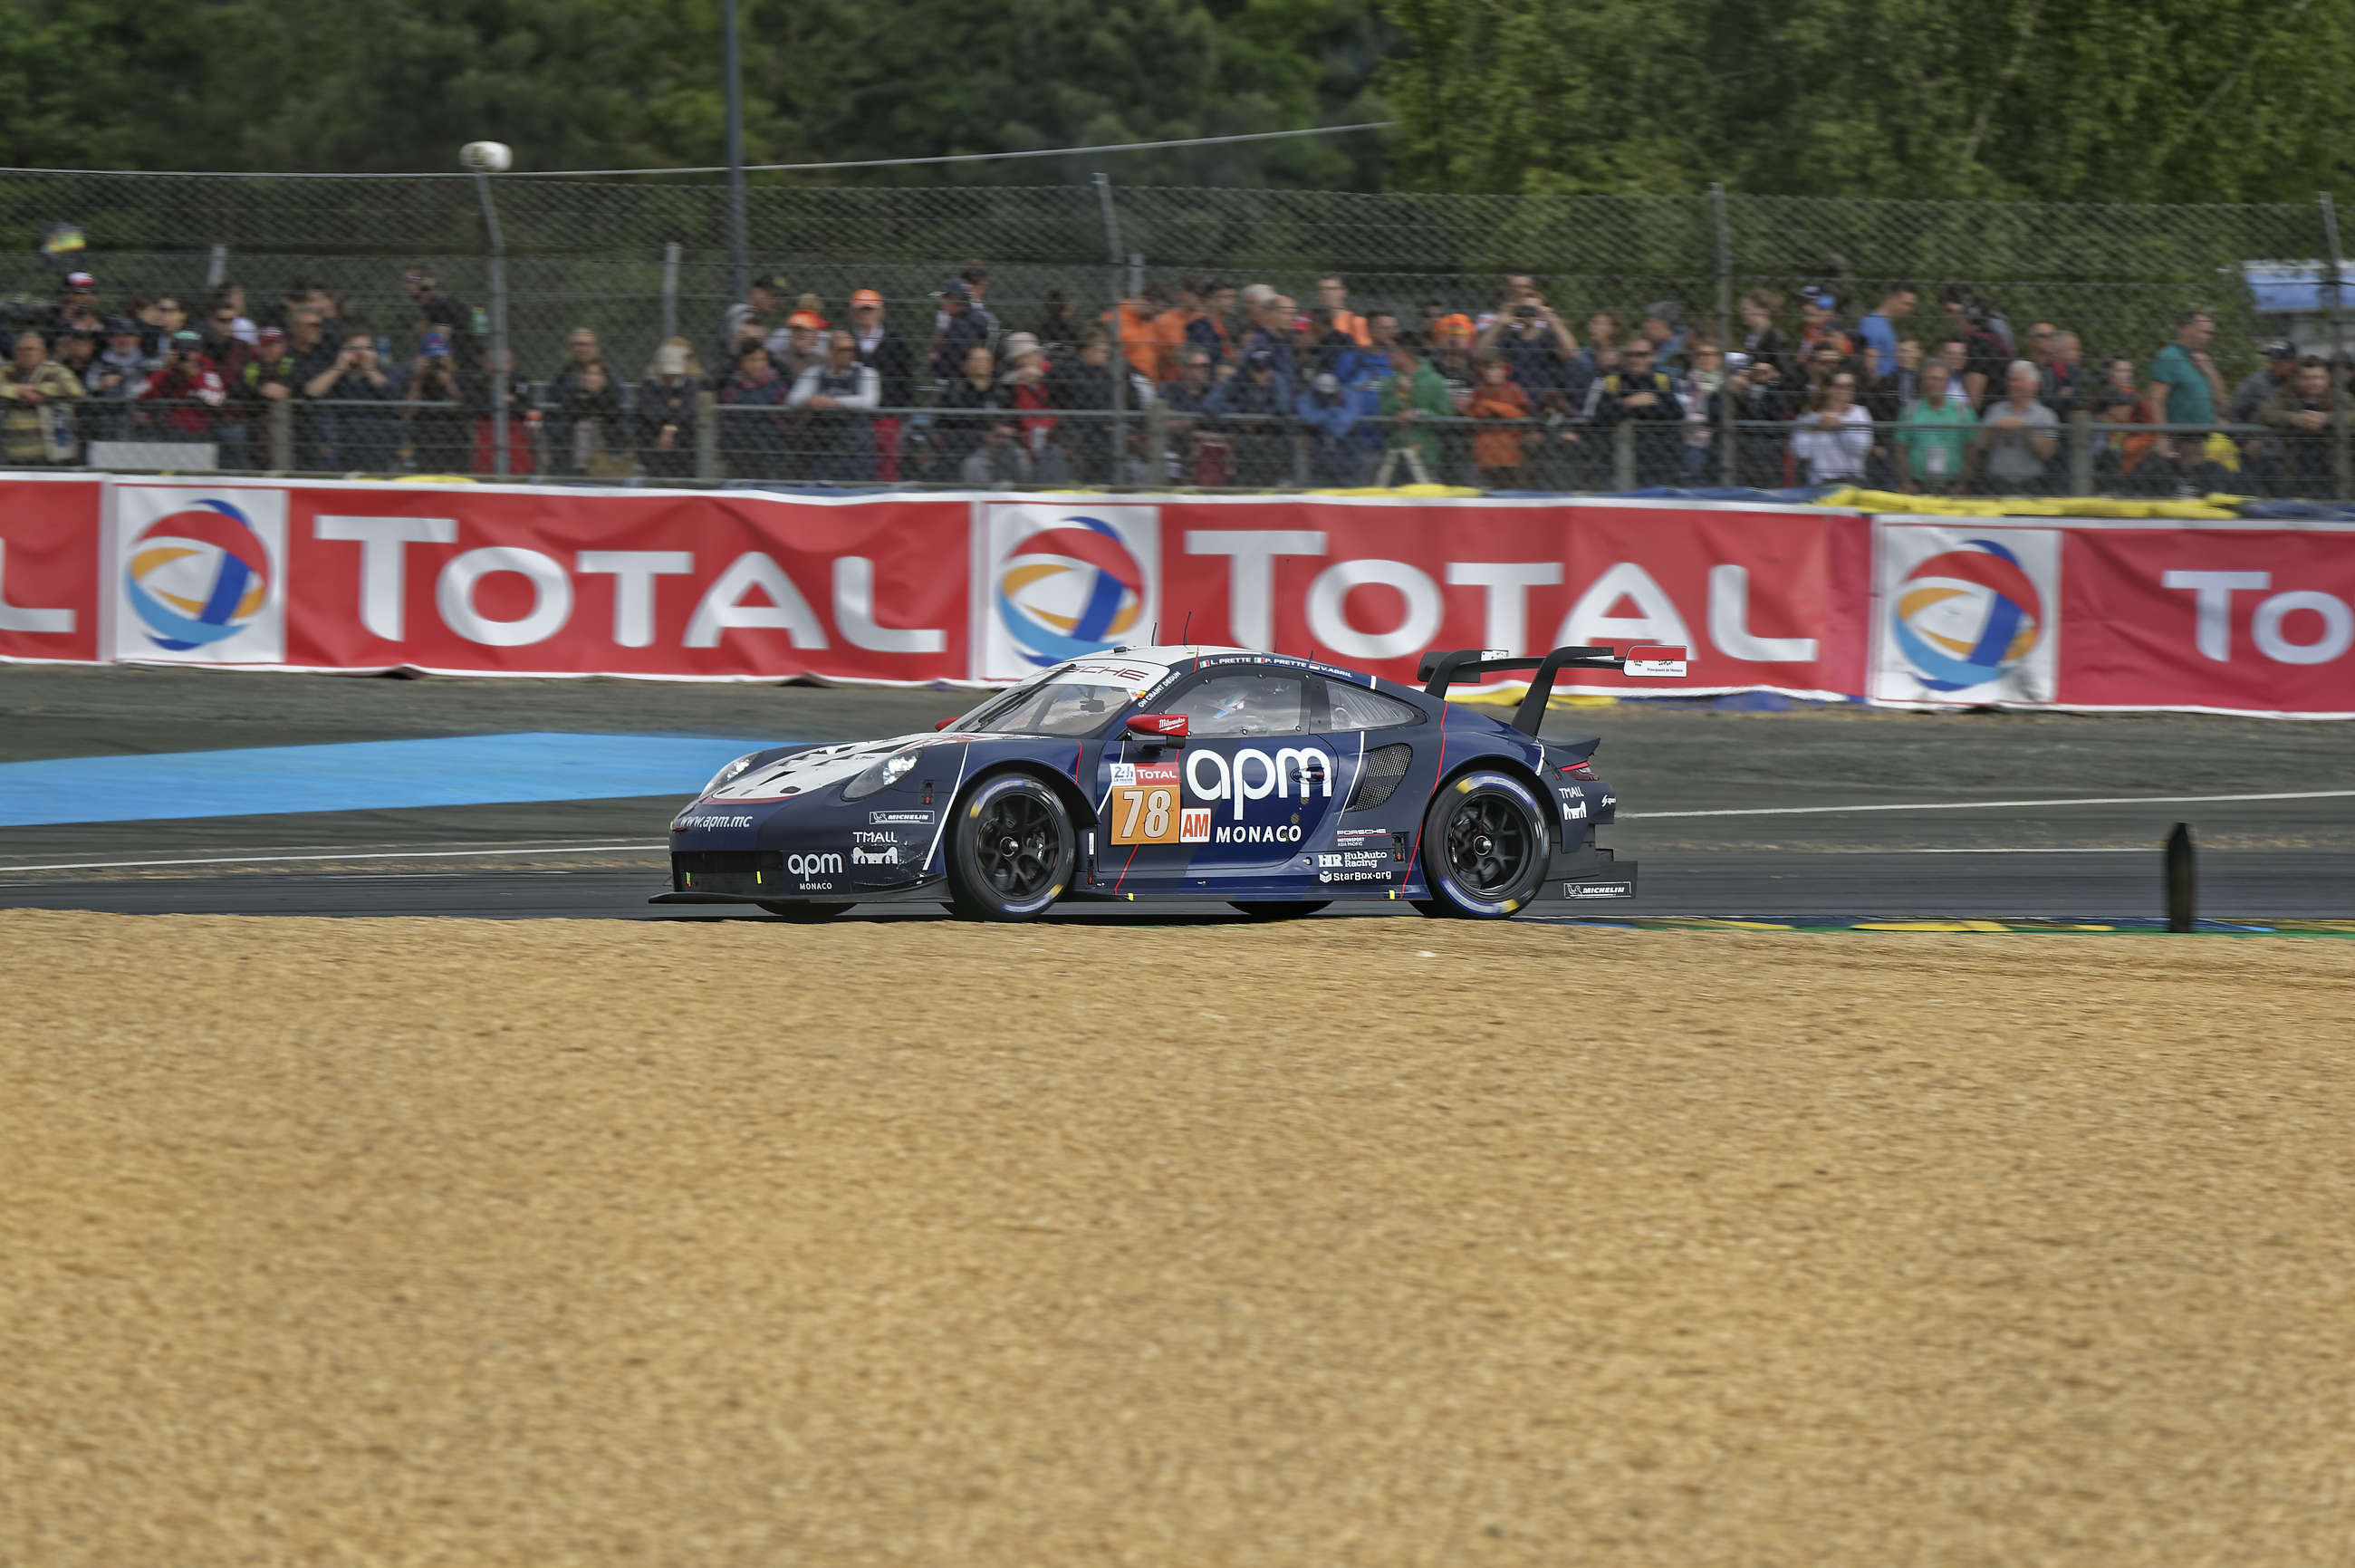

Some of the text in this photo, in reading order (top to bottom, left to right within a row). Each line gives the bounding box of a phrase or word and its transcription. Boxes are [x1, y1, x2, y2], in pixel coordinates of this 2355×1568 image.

[313, 515, 947, 653] TOTAL
[1183, 530, 1819, 662] TOTAL
[2162, 570, 2354, 666] TO
[1274, 659, 1306, 668] PRETTE
[1137, 769, 1177, 780] TOTAL
[1187, 748, 1332, 820] apm
[1559, 786, 1584, 799] TMALL
[1121, 790, 1172, 839] 78
[679, 816, 754, 832] www.apm.mc
[1182, 813, 1209, 838] AM
[852, 831, 898, 843] TMALL
[1216, 825, 1302, 843] MONACO
[1344, 851, 1387, 860] HubAuto
[1345, 860, 1377, 868] Racing
[787, 853, 843, 882] apm
[799, 882, 832, 890] MONACO
